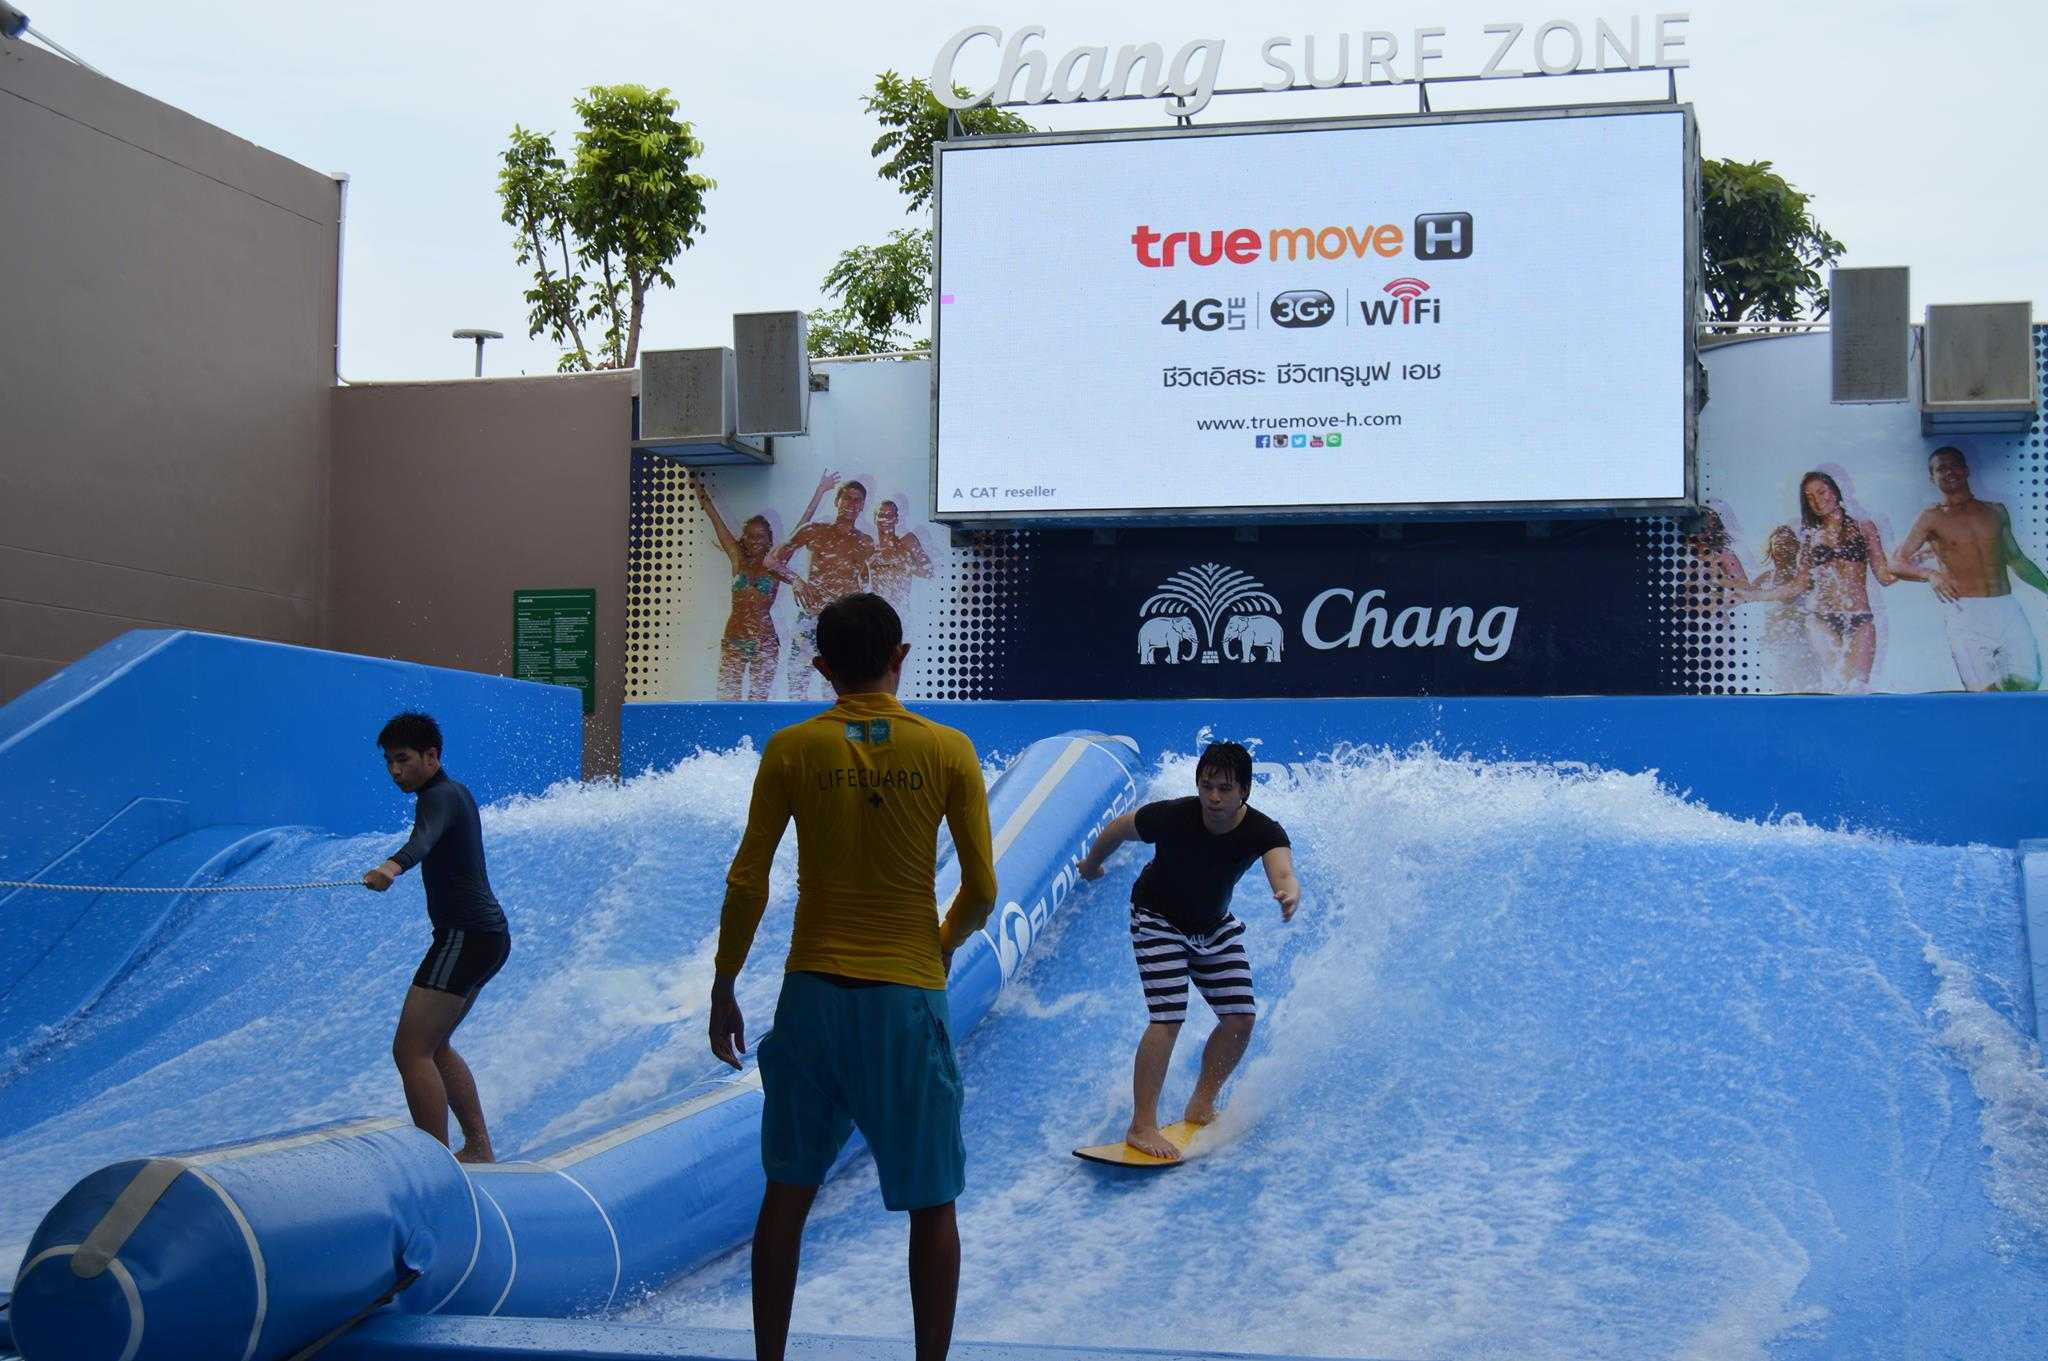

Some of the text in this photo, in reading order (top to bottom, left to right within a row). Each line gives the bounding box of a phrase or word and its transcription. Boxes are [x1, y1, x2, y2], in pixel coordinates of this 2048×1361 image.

[931, 12, 1691, 118] Chang SURF ZONE
[1160, 298, 1225, 333] 4G
[1227, 296, 1246, 331] LTE
[1162, 365, 1267, 388] ชีวิตอิสระ
[1196, 411, 1402, 431] www.truemove-h.com
[953, 485, 1057, 499] A CAT reseller
[1301, 587, 1520, 662] Chang
[817, 768, 923, 791] LIFEGUARD
